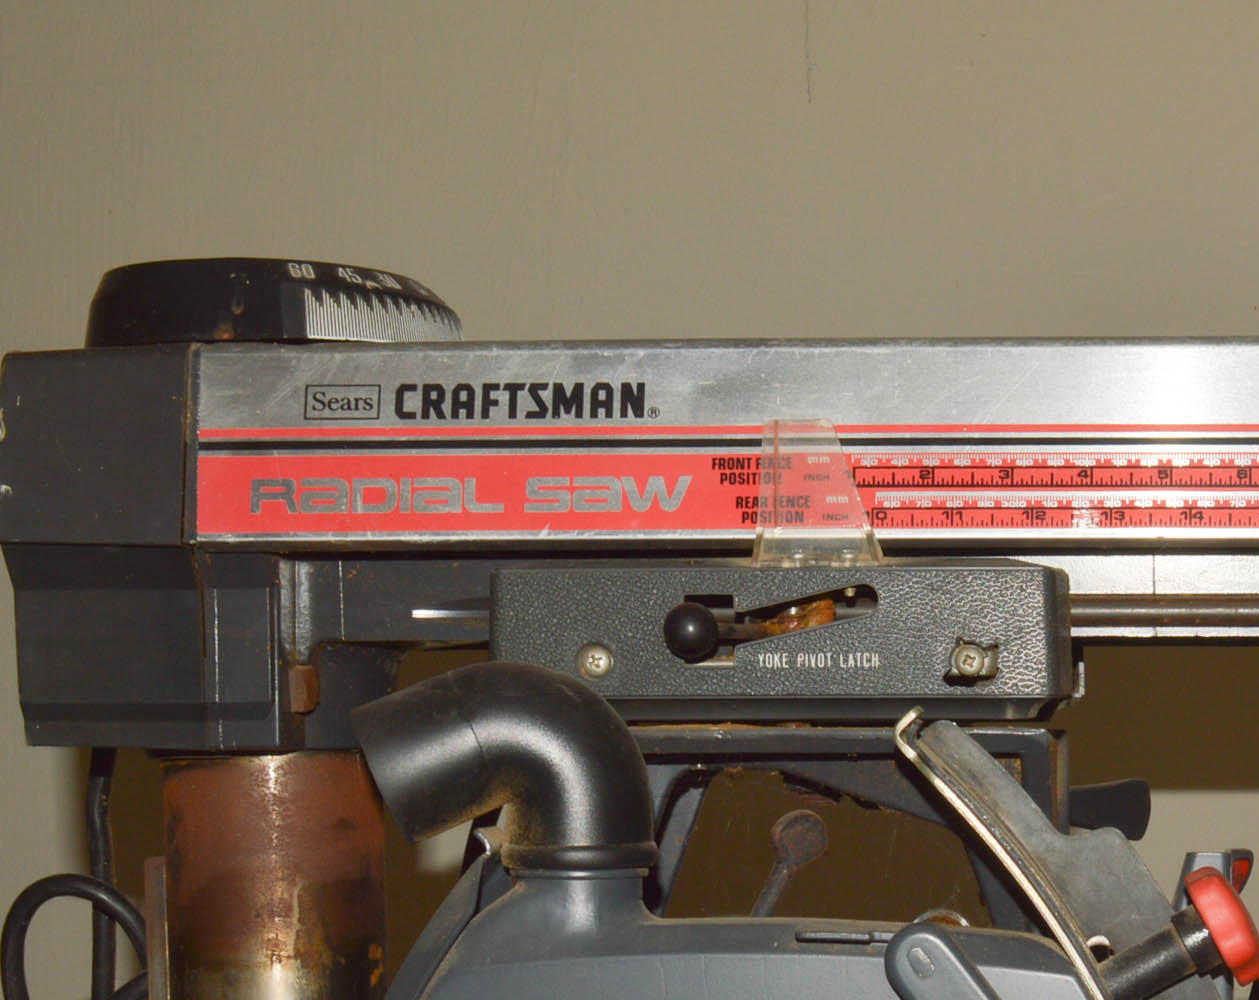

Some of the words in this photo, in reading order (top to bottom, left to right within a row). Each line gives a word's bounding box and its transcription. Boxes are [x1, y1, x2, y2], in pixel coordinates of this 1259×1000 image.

[288, 263, 315, 279] 60
[338, 268, 362, 283] 45
[311, 391, 374, 411] Sears
[395, 382, 646, 420] CRAFTSMAN
[711, 457, 752, 470] FRONT
[808, 456, 830, 464] mm
[804, 473, 830, 481] INCH
[920, 469, 931, 479] 2
[999, 469, 1009, 479] 3
[1078, 469, 1090, 479] 4
[1158, 469, 1169, 479] 5
[1237, 469, 1248, 479] 6
[736, 496, 768, 509] REAR
[775, 496, 811, 508] ENCE
[826, 495, 849, 503] mm
[823, 513, 849, 521] INCH
[758, 653, 789, 668] YOKE
[797, 653, 832, 668] PIVOT
[839, 653, 880, 668] LATCH
